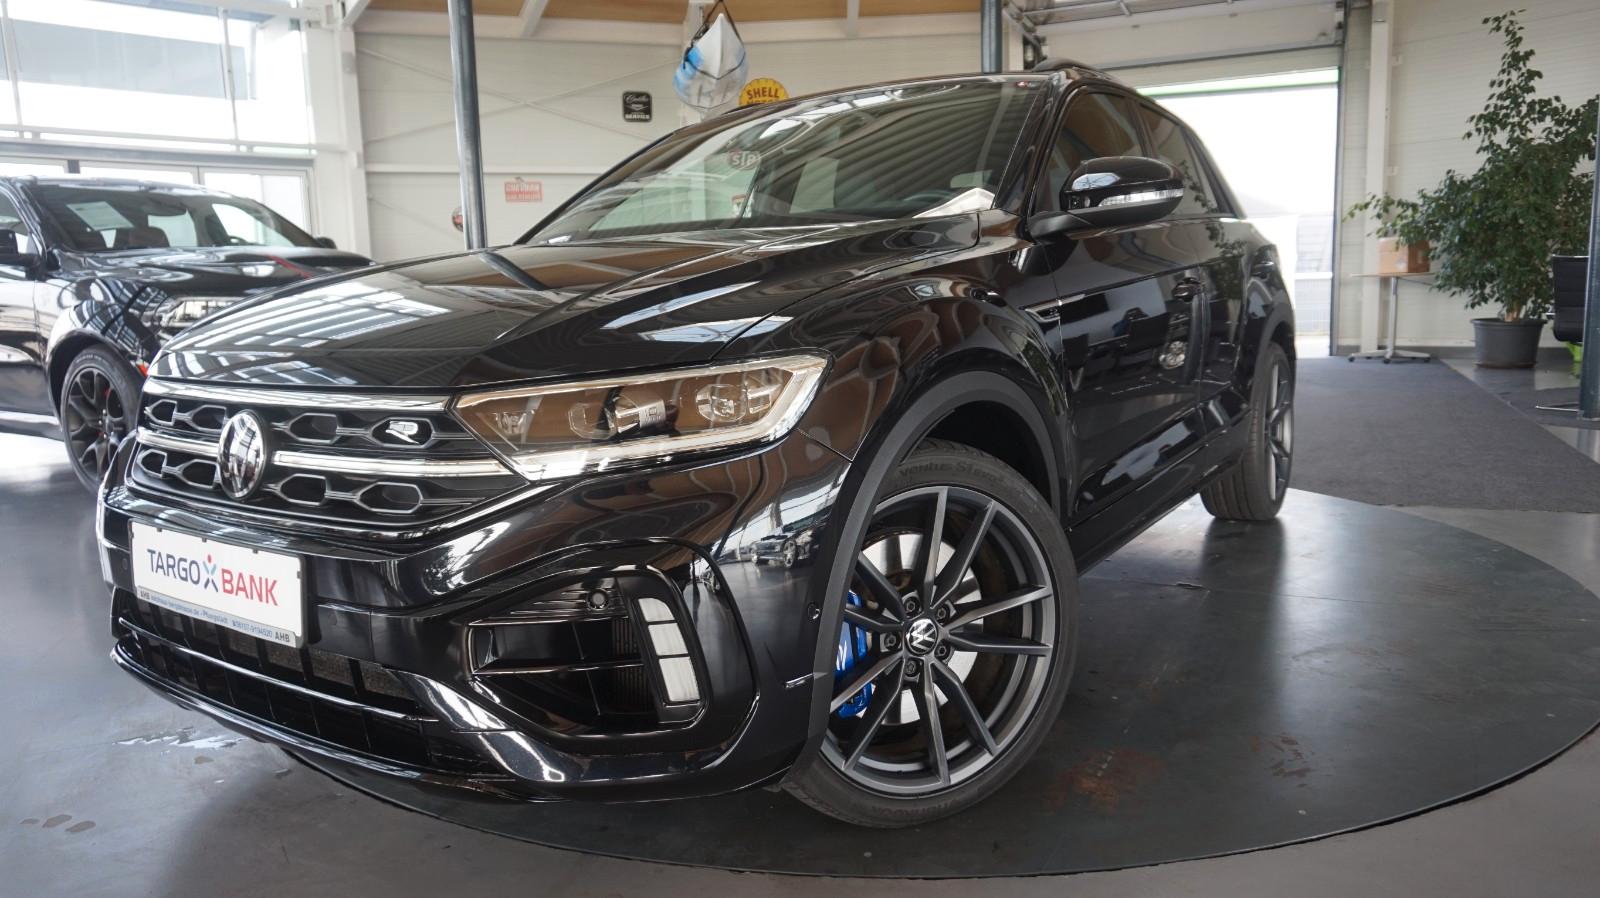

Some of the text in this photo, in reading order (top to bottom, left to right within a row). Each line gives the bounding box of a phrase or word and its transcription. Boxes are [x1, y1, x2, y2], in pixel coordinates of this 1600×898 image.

[746, 86, 780, 100] SHELL
[147, 548, 201, 585] TARGO
[221, 567, 279, 607] BANK
[275, 631, 290, 643] AHB
